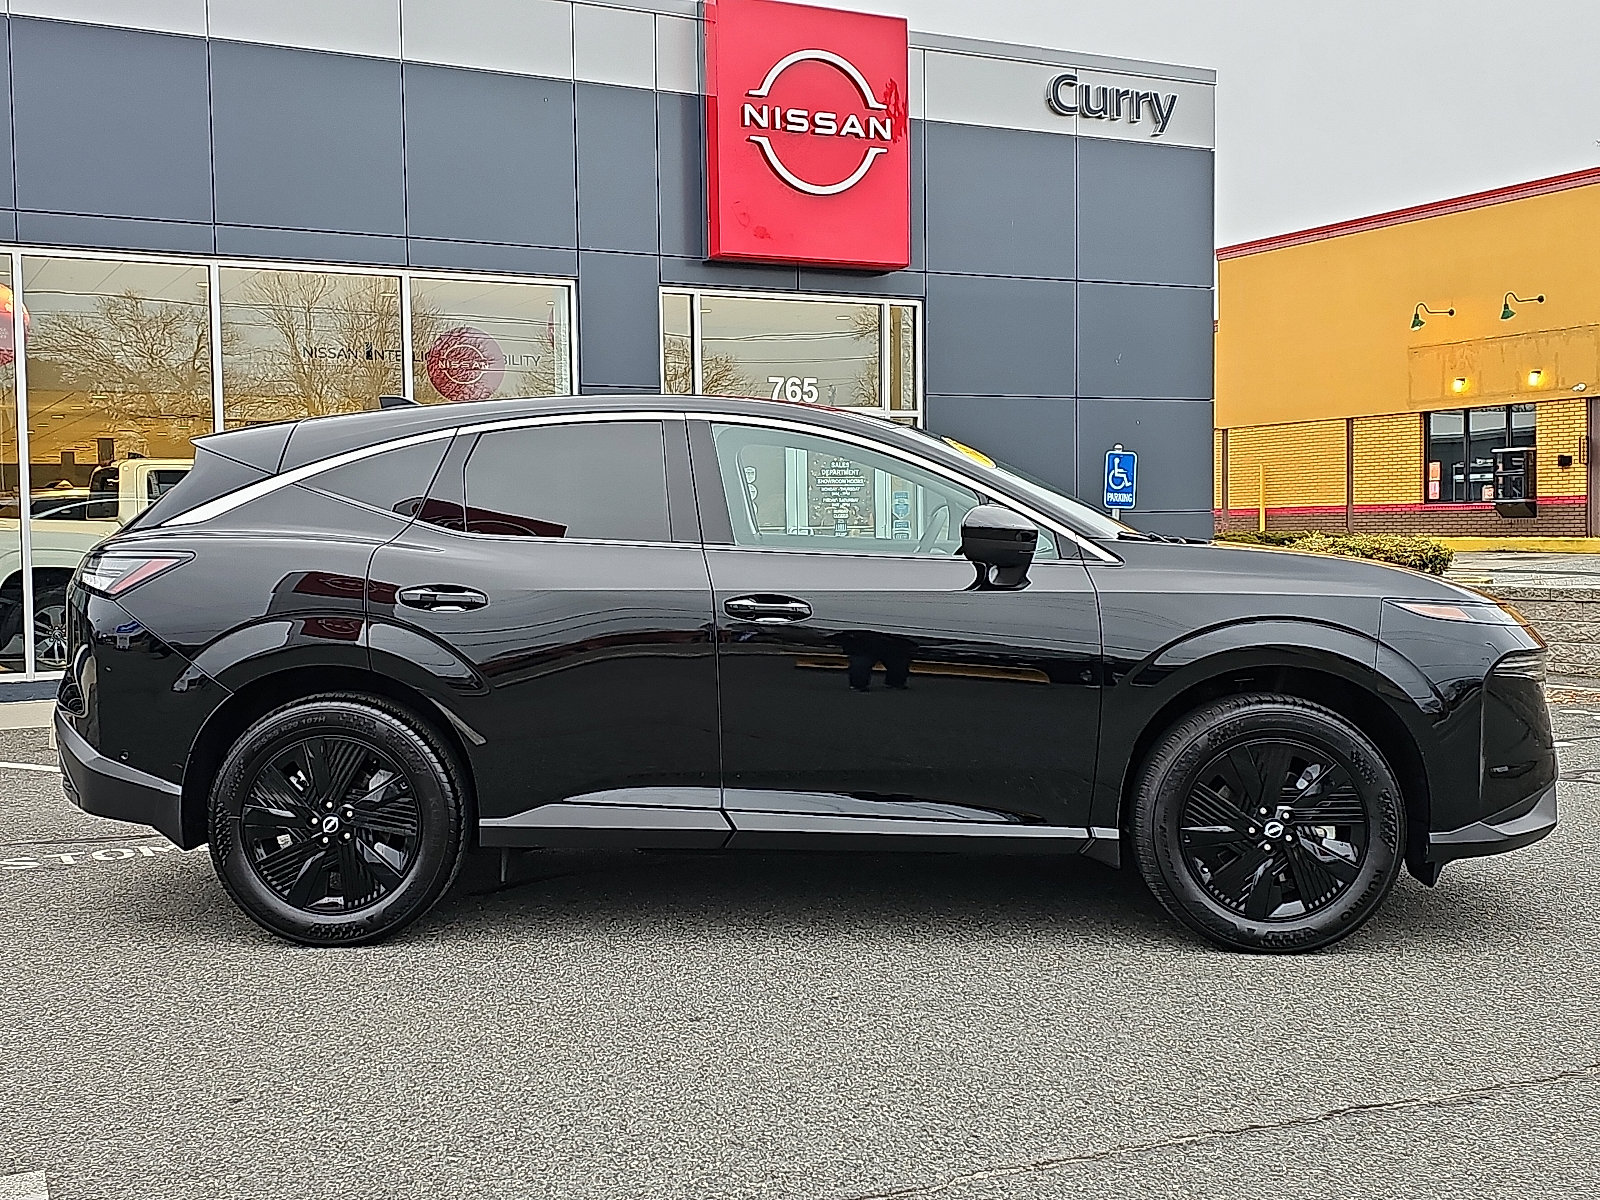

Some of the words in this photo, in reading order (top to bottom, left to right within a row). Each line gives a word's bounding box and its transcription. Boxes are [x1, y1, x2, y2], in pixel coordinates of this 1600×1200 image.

[1046, 73, 1178, 136] Curry
[742, 103, 892, 141] NISSAN
[303, 346, 358, 359] NISSAN
[502, 354, 540, 367] BILITY
[438, 361, 489, 370] NISSAN
[767, 376, 818, 403] 765
[1107, 492, 1133, 503] PARKING
